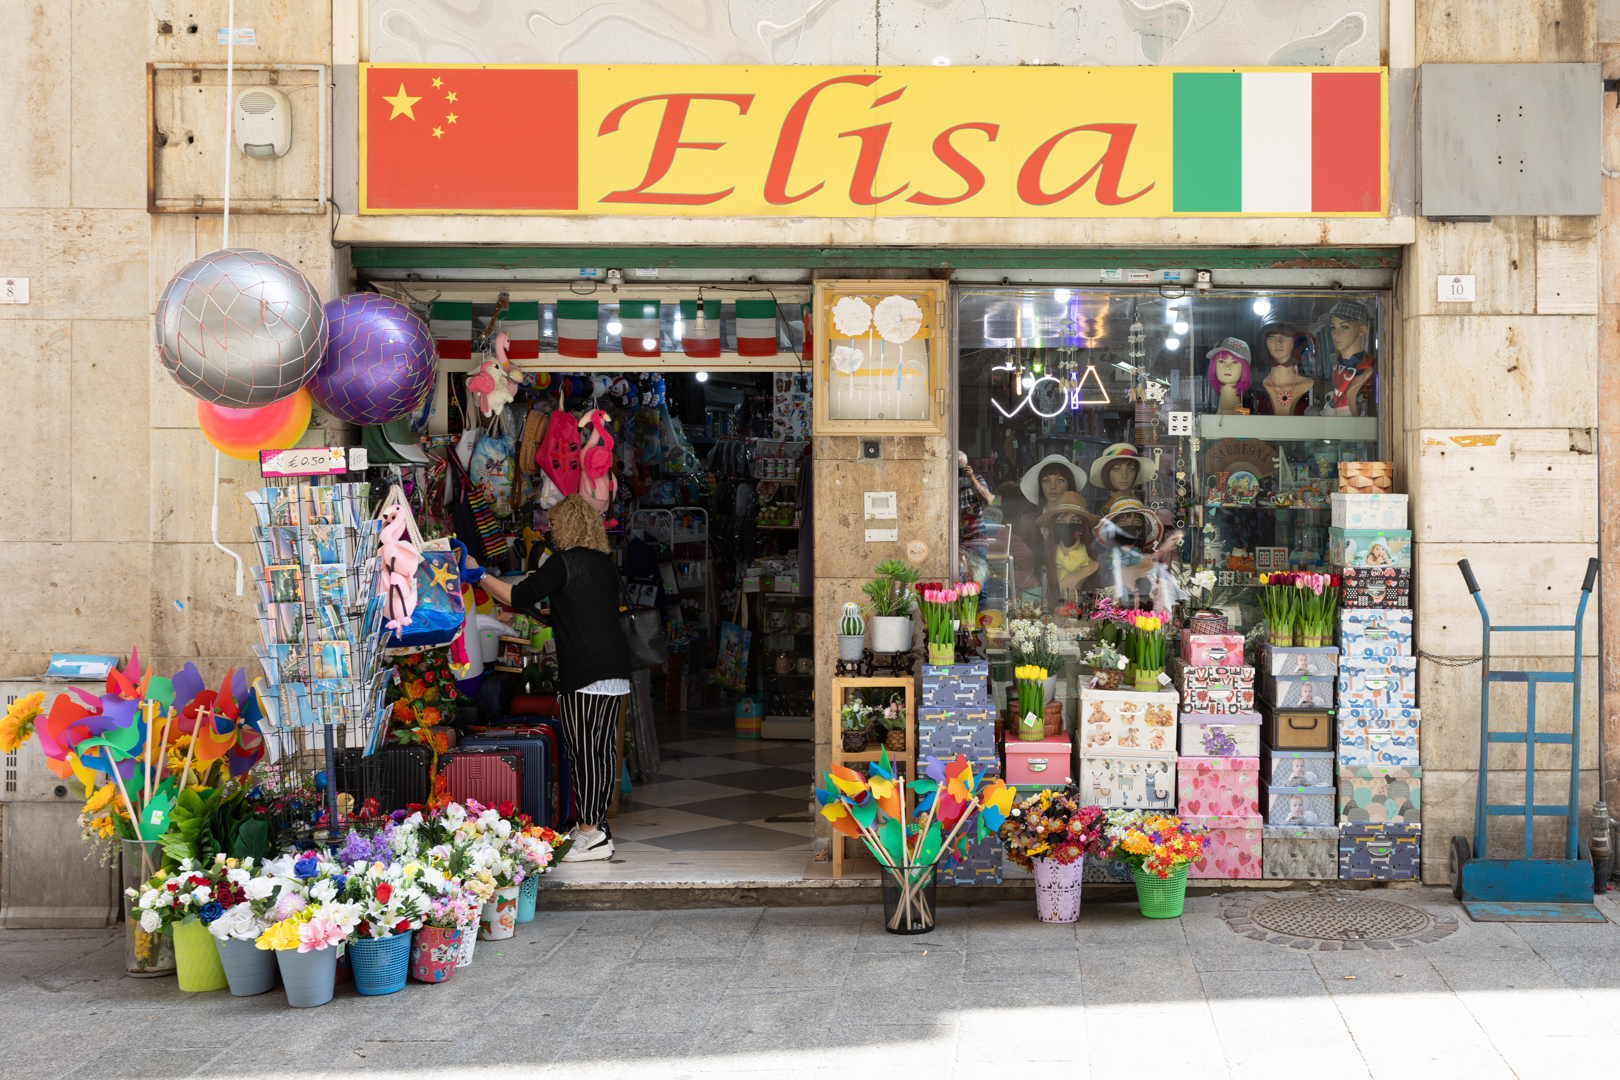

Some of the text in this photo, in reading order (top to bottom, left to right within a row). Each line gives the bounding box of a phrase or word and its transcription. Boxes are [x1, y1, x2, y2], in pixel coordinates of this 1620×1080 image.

[597, 74, 1156, 206] Elisa
[6, 286, 14, 298] 8
[1450, 284, 1464, 296] 10
[1212, 443, 1269, 463] SARDEGNA
